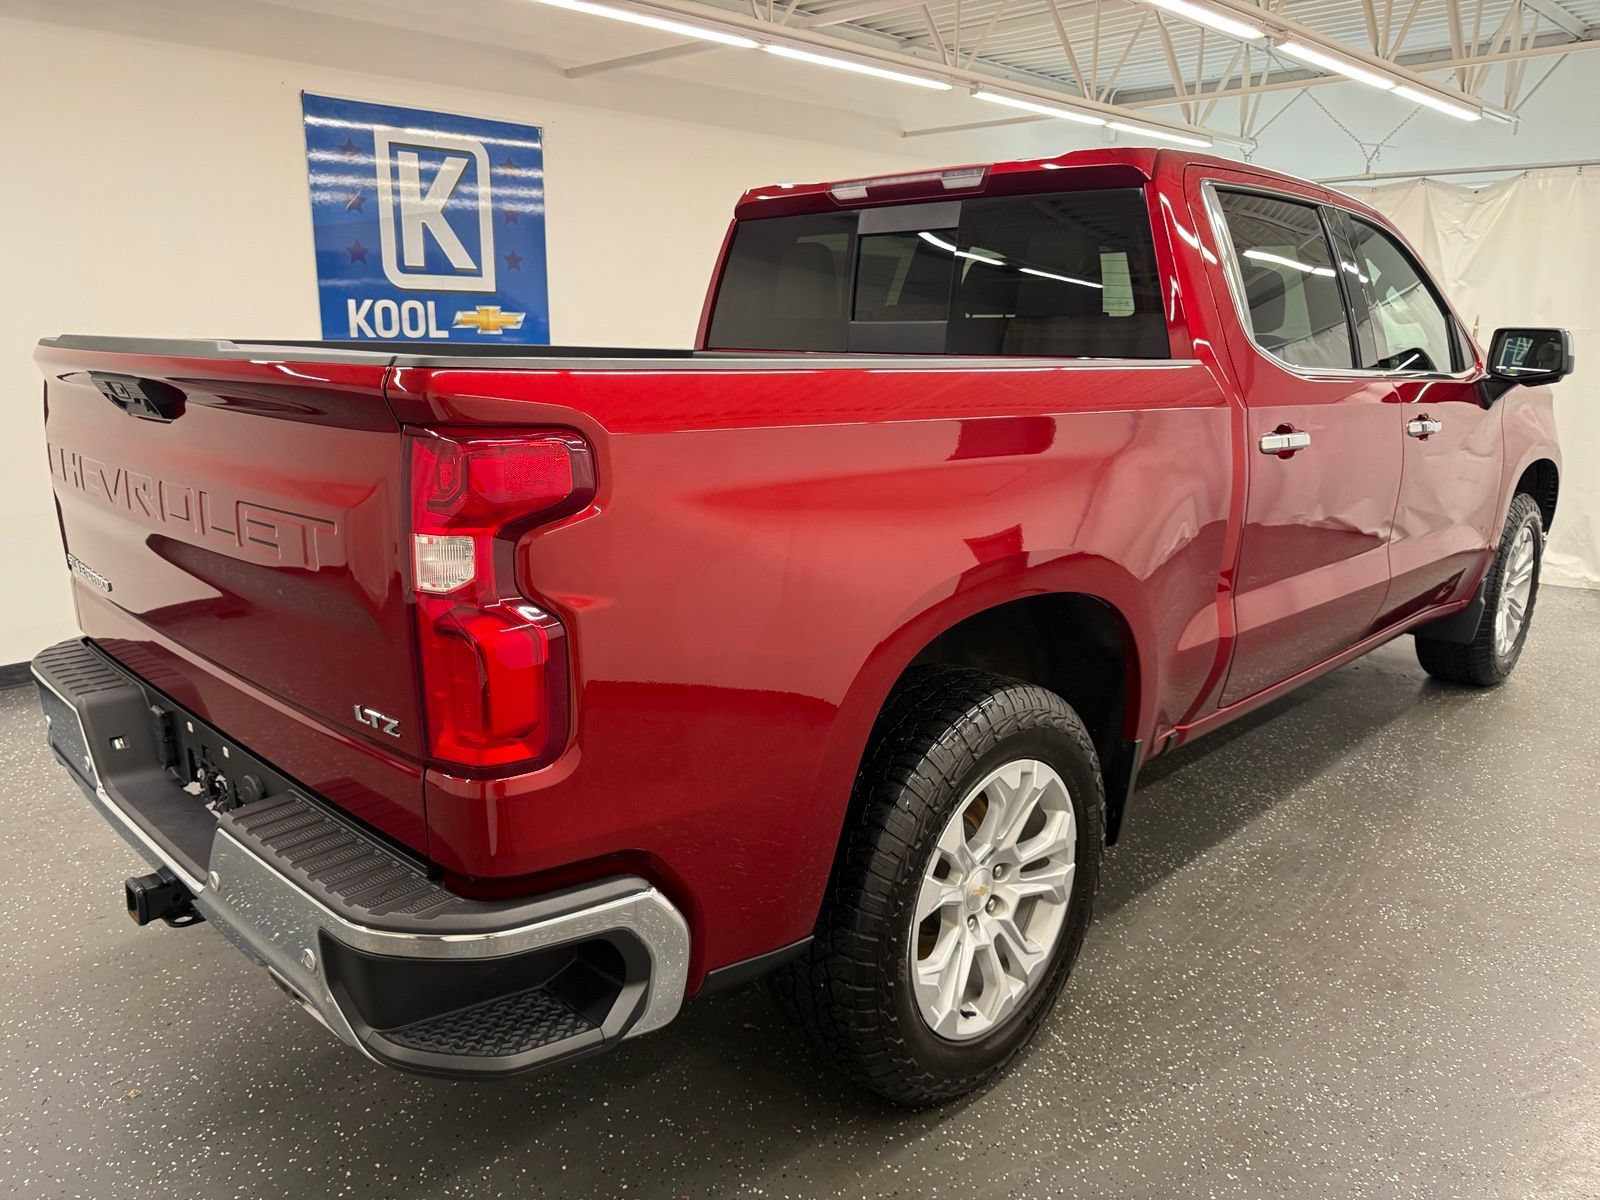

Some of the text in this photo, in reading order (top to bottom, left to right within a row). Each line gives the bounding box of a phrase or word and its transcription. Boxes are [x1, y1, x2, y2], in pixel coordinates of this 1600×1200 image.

[397, 151, 477, 269] K
[347, 299, 449, 338] KOOL
[48, 442, 338, 571] CHEVROLET
[354, 705, 401, 738] LTZ
